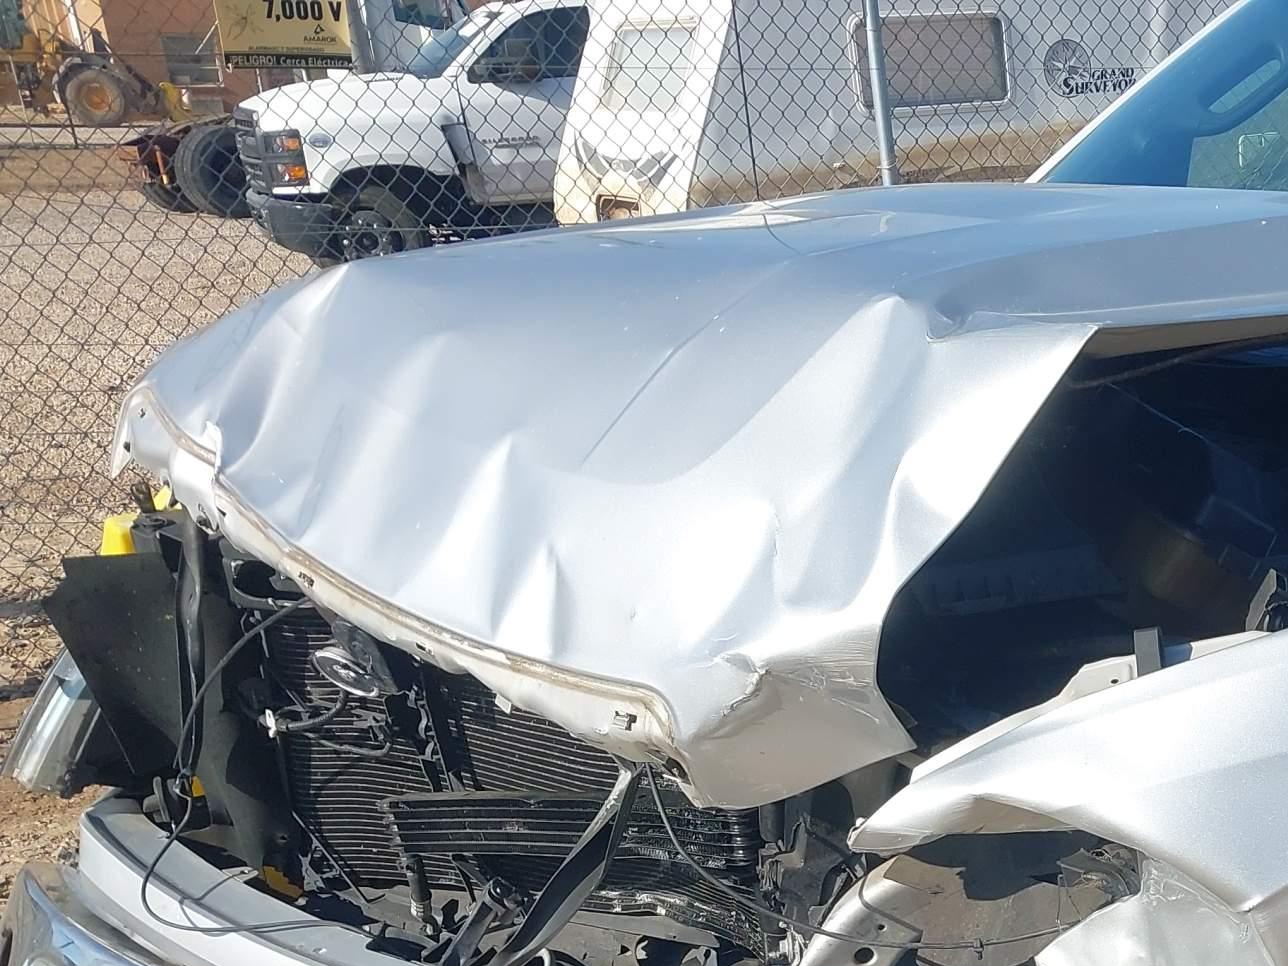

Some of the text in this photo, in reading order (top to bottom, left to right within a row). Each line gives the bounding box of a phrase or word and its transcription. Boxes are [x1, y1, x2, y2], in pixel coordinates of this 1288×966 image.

[262, 0, 341, 22] 7,000 V
[280, 56, 306, 66] Cerca
[308, 57, 349, 67] Eléctrica
[1092, 67, 1134, 81] GRAND
